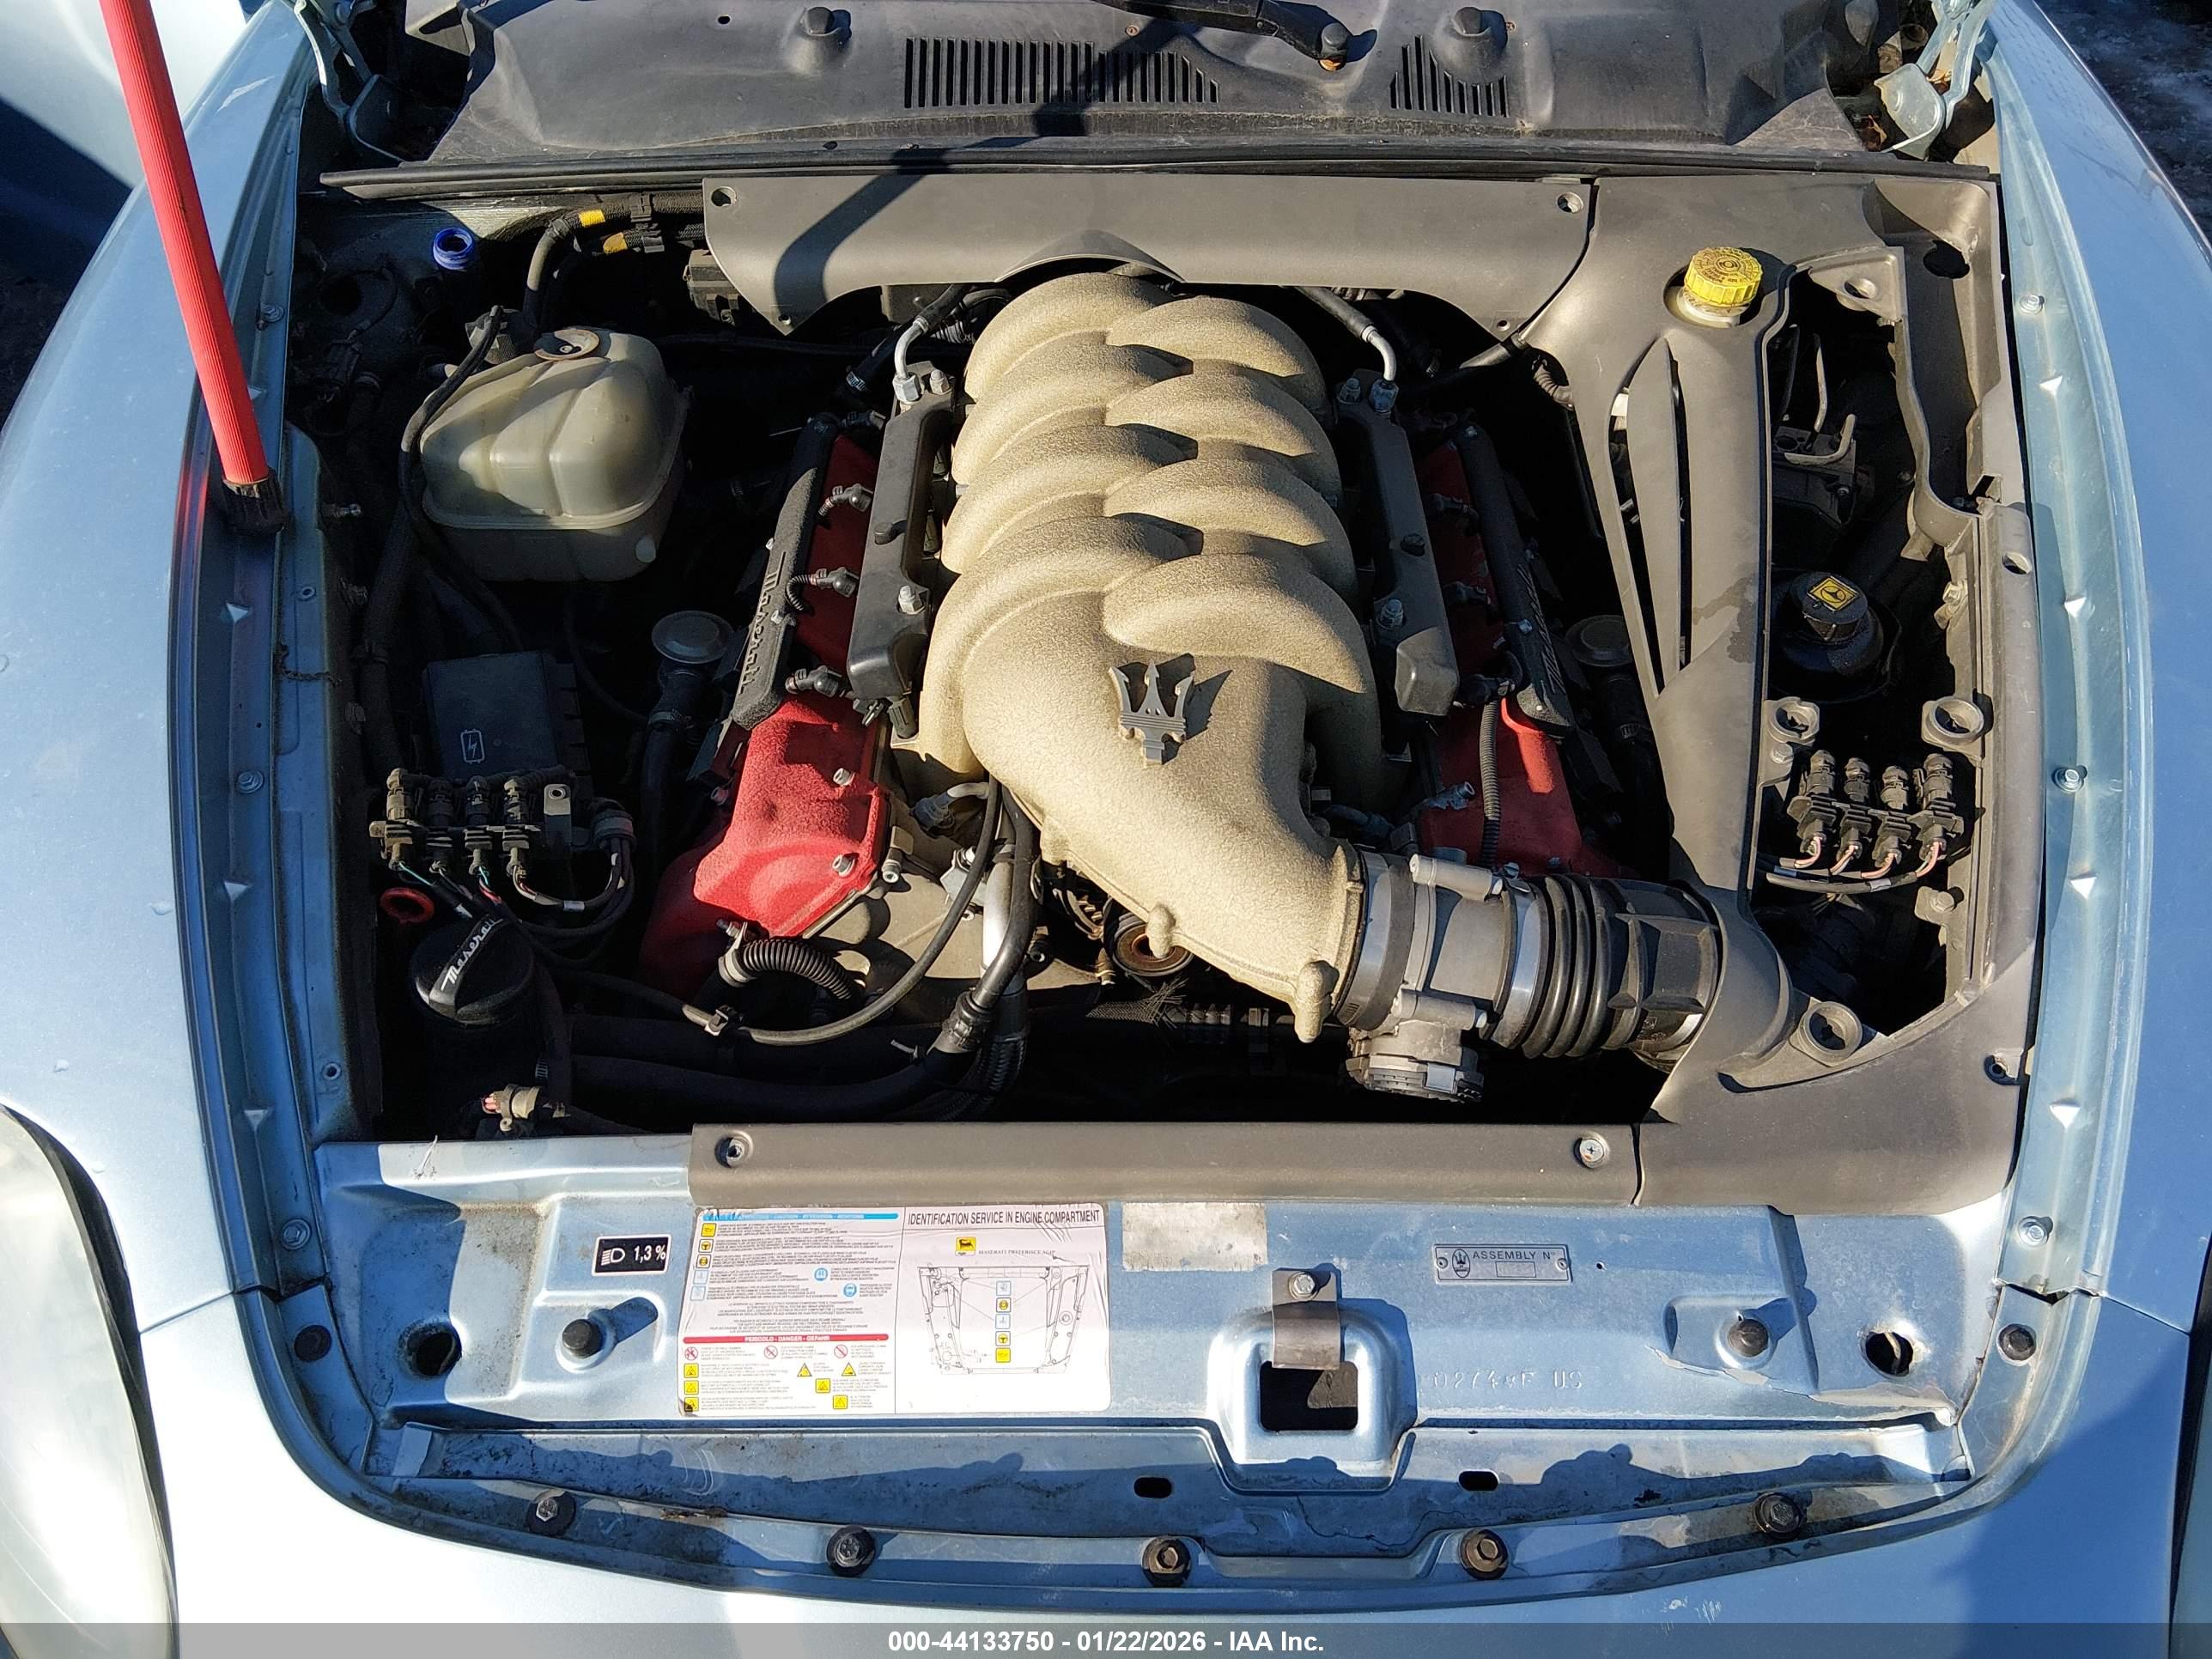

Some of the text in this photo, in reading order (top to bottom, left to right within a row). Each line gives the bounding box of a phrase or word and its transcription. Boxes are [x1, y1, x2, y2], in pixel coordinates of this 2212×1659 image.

[441, 919, 503, 991] Maserati
[908, 1210, 1100, 1224] IDENTIFICATION SERVICE IN ENGINE COMPARTMENT
[634, 1244, 666, 1264] 1,3 %
[1473, 1250, 1536, 1260] ASSEMBLY
